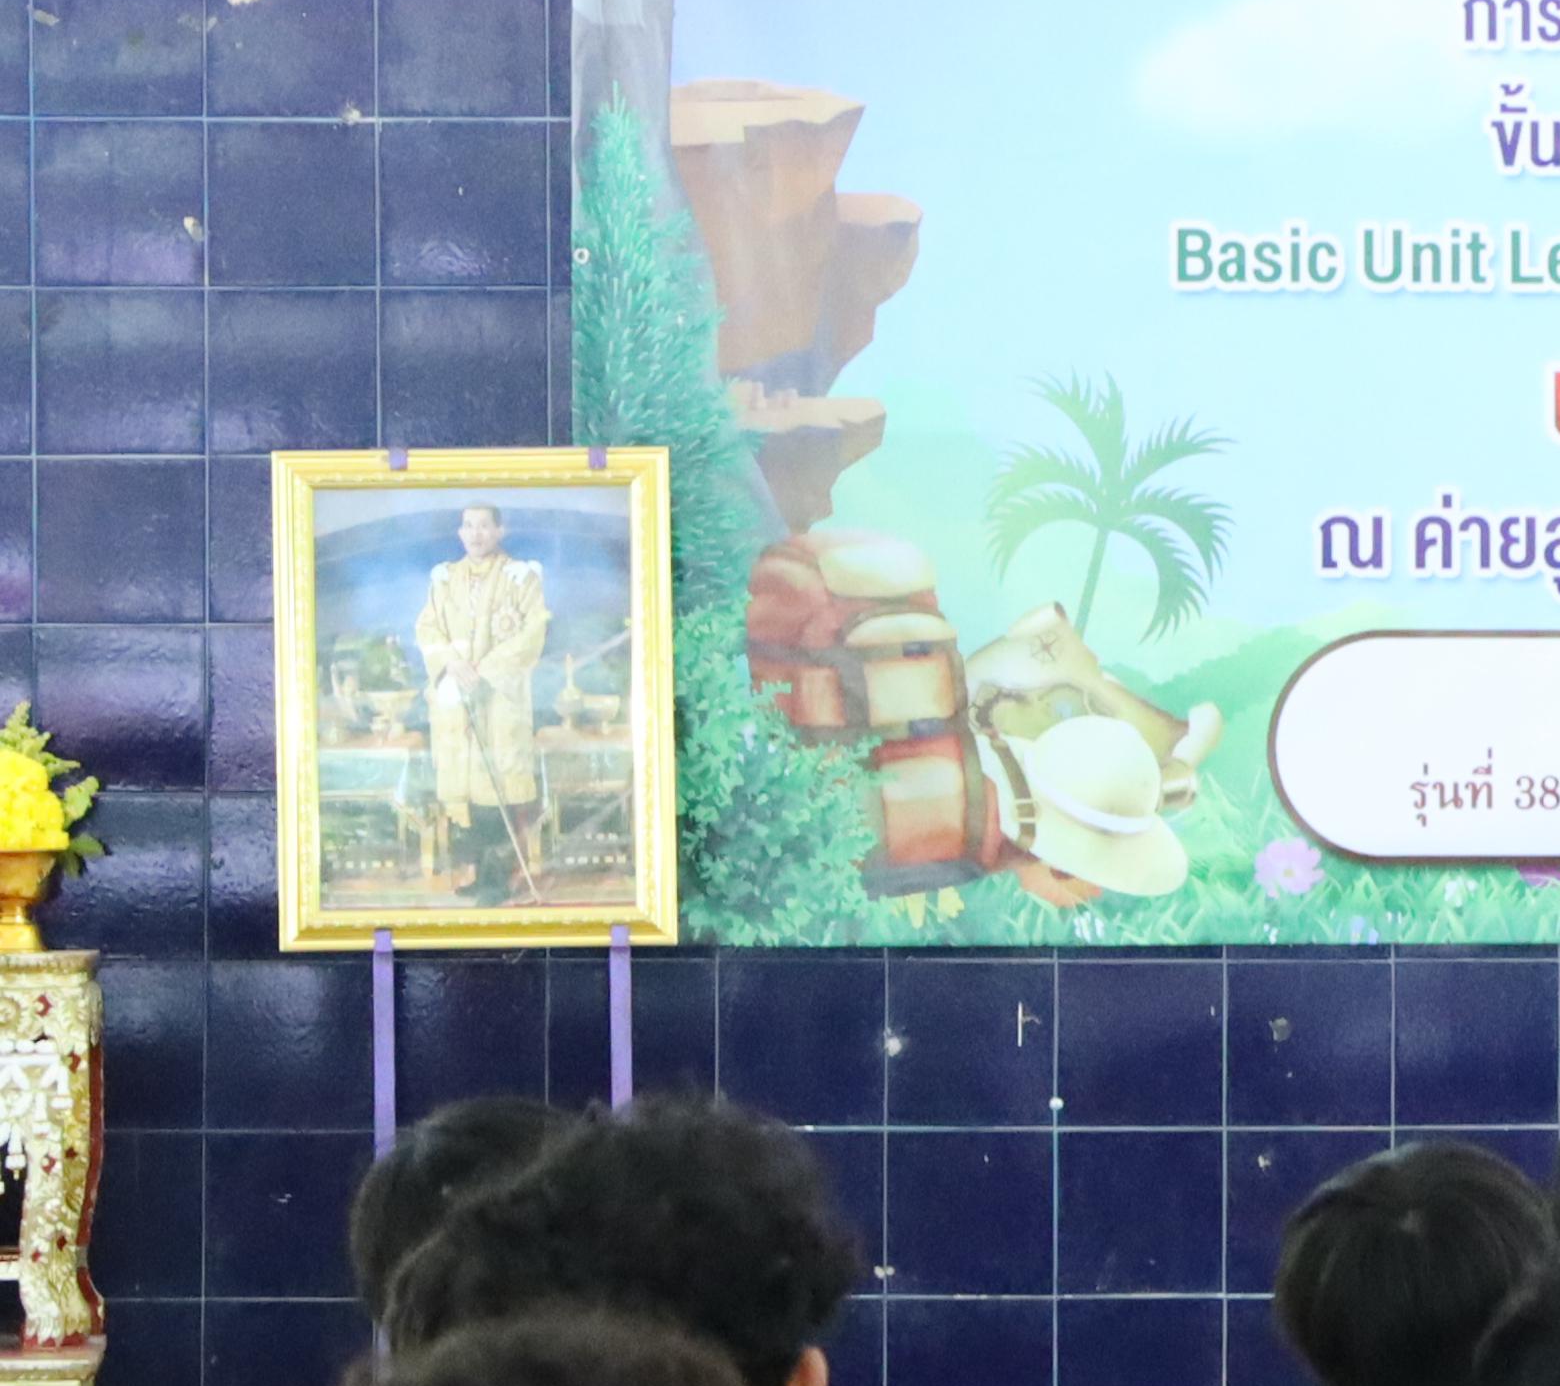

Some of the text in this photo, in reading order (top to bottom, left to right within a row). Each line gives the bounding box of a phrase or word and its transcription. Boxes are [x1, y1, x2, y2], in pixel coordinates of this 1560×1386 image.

[1176, 227, 1337, 286] Basic
[1363, 228, 1487, 286] Unit
[1319, 516, 1384, 570] ณ
[1410, 747, 1494, 826] รุ่นที่
